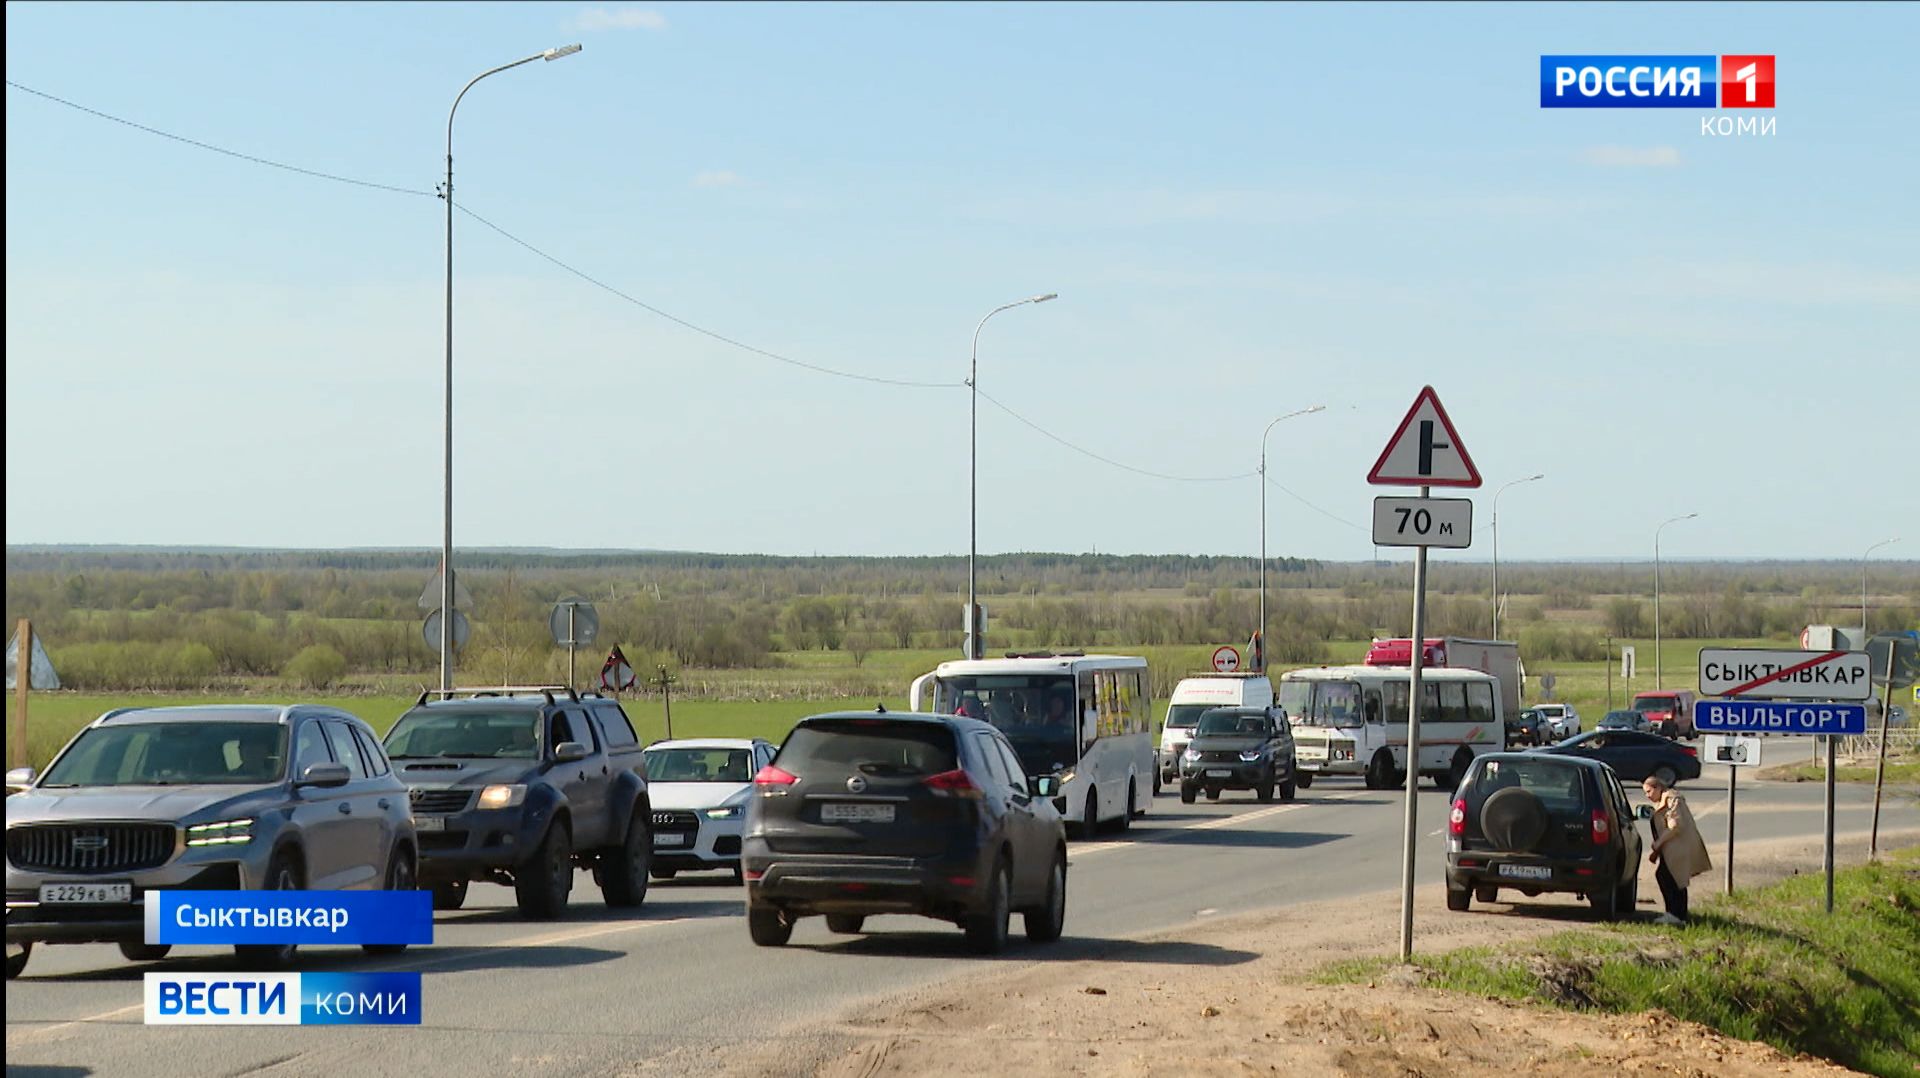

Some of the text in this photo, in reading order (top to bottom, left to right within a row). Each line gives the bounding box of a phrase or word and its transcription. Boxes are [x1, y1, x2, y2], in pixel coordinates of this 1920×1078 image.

[1394, 508, 1432, 535] 70
[1705, 662, 1865, 685] СЫКТЫВКАР
[1710, 706, 1851, 729] ВЫЛЬГОРТ
